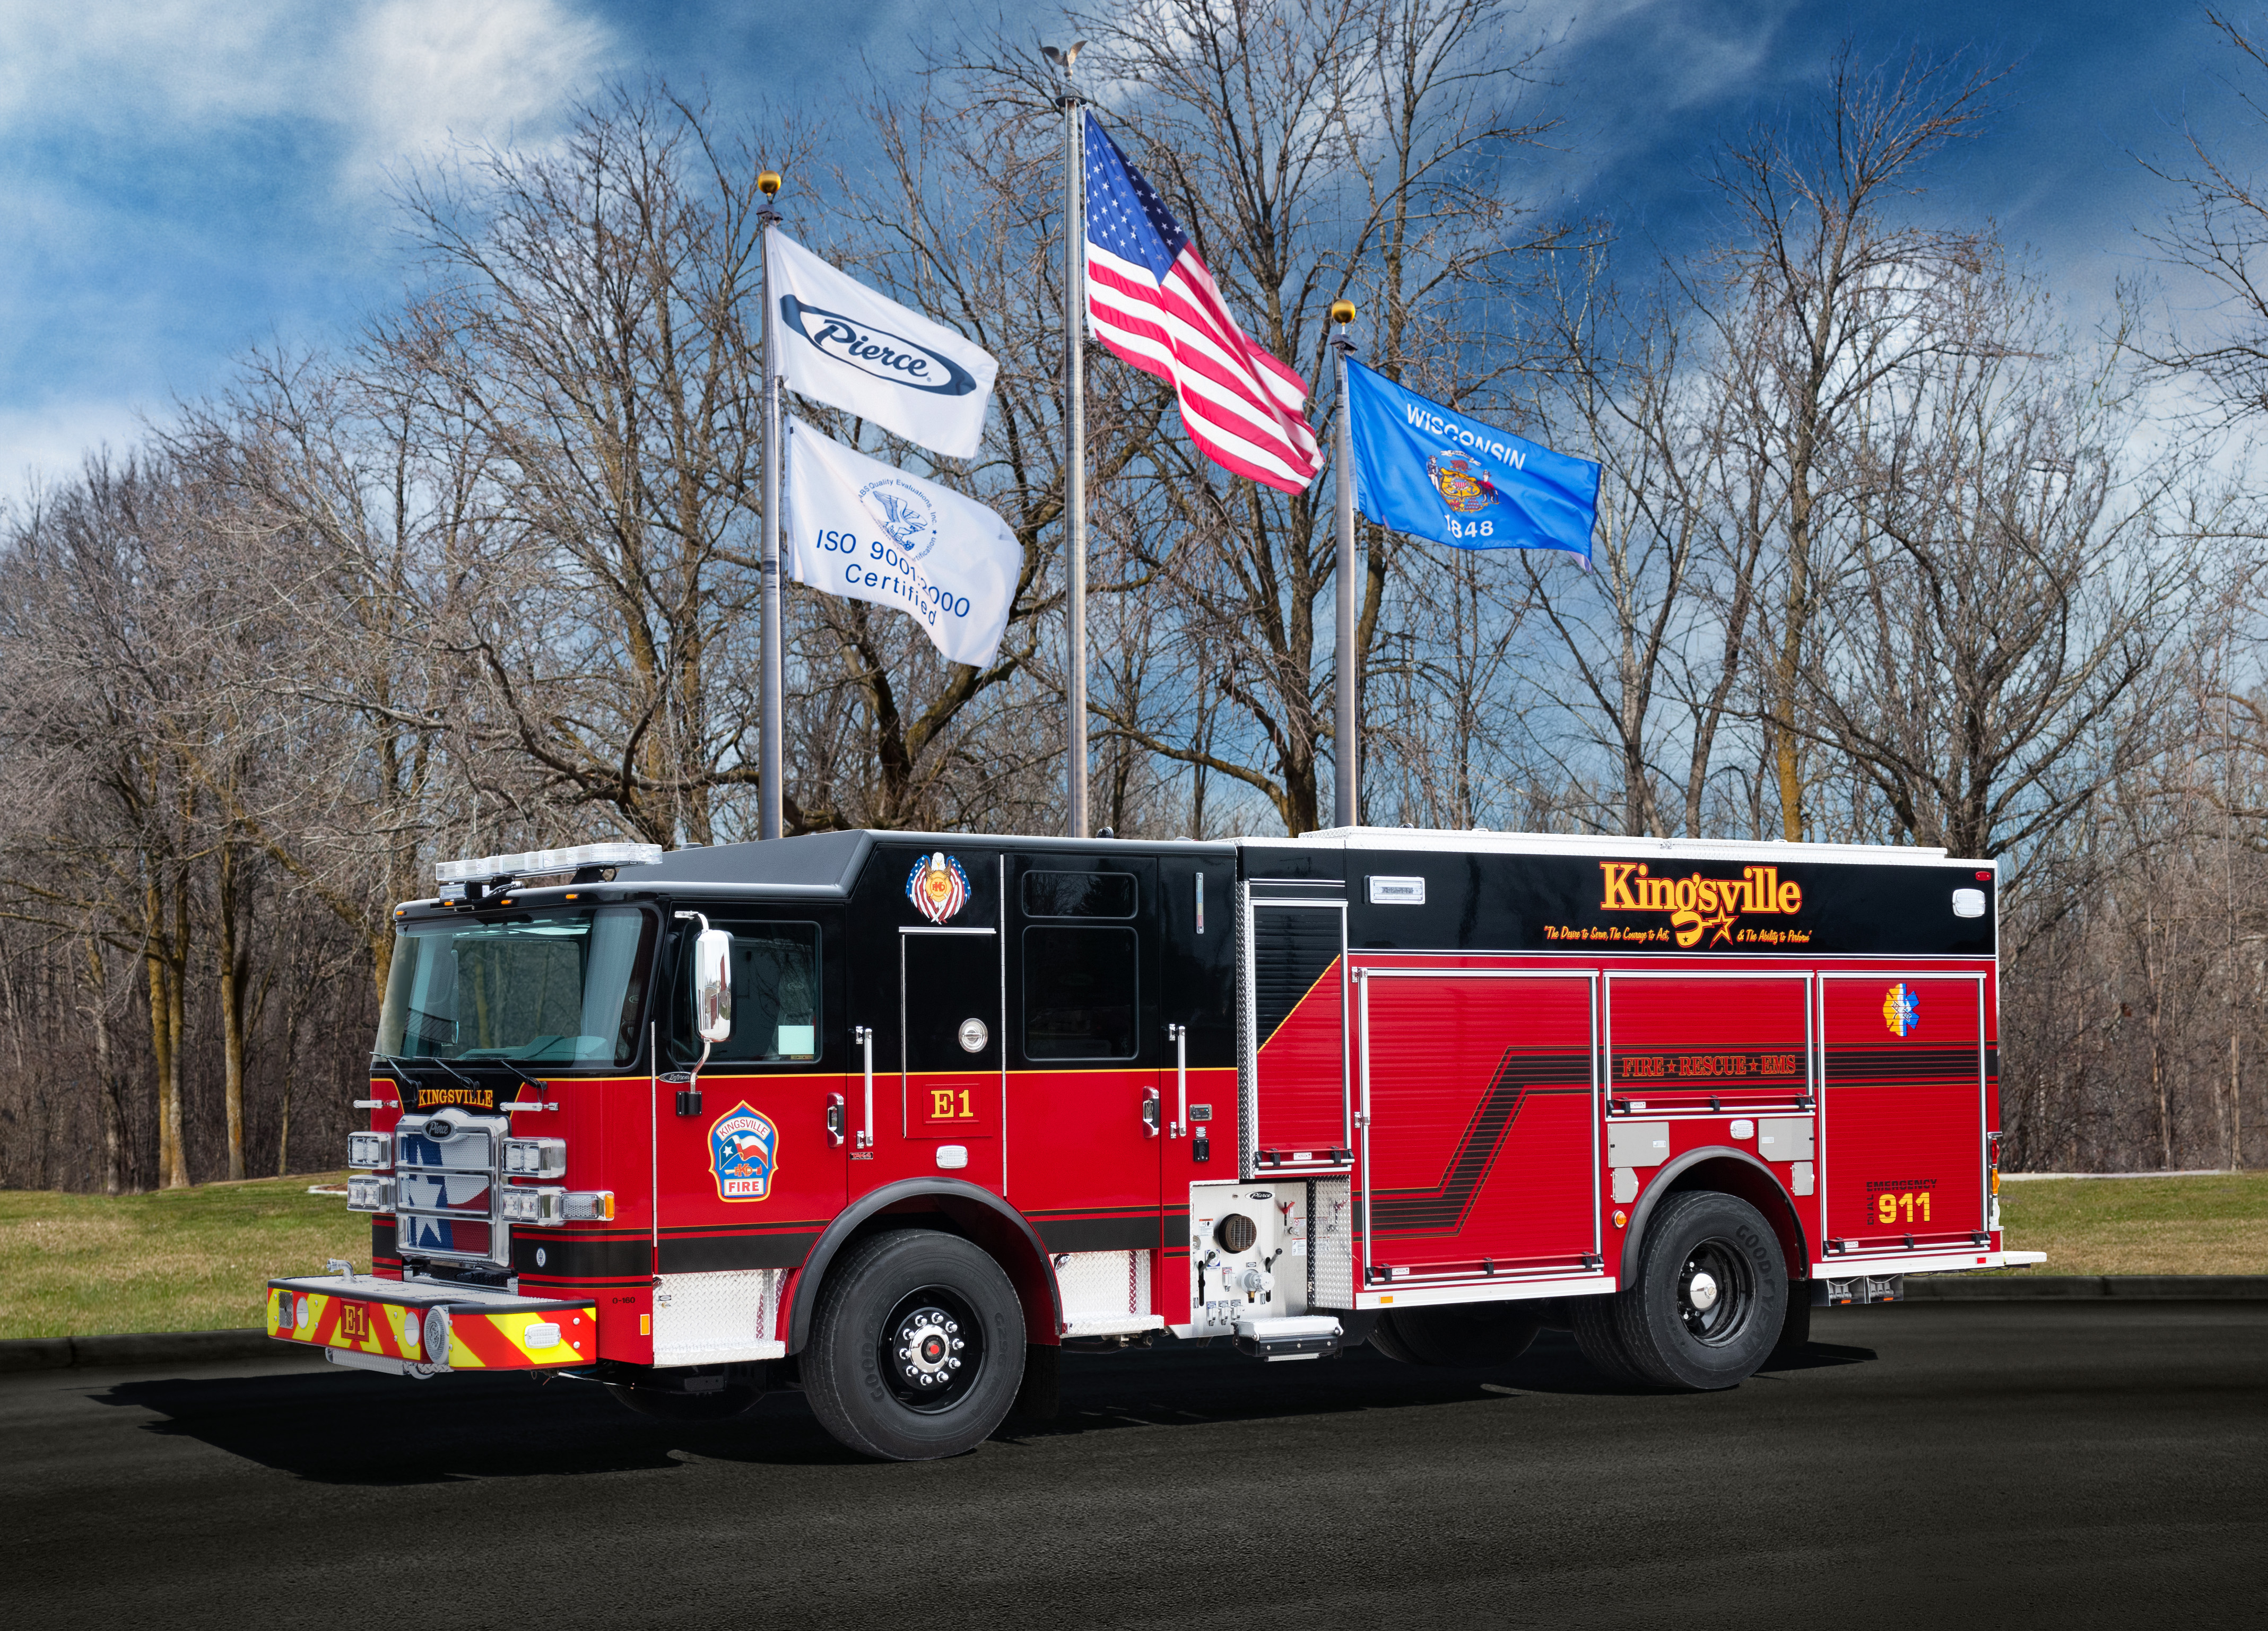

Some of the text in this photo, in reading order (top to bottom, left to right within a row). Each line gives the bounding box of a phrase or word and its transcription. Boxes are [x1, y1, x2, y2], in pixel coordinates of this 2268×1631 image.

[814, 319, 929, 377] Pierce
[1407, 404, 1526, 470] WISCONSIN
[858, 485, 870, 500] ABS
[868, 478, 893, 490] Quality
[1444, 514, 1493, 539] 1848
[816, 529, 856, 554] ISO
[845, 564, 937, 626] Certified
[1599, 862, 1803, 948] Kingsville
[1560, 926, 1580, 940] Desire
[1581, 928, 1589, 940] to
[1590, 927, 1609, 941] Serve,
[1610, 927, 1622, 940] The
[1623, 927, 1647, 944] Courage
[1648, 929, 1656, 940] to
[1656, 927, 1670, 941] Act,
[1736, 929, 1745, 942] &
[1746, 929, 1757, 942] The
[1758, 929, 1778, 945] Ability
[1779, 931, 1786, 943] to
[1622, 1054, 1796, 1077] FIRE RESCUE EMS
[418, 1089, 493, 1110] KINGSVILLE
[931, 1089, 974, 1118] E1
[429, 1121, 448, 1136] Pierce
[719, 1119, 768, 1137] KINGSVILLE
[729, 1181, 759, 1192] FIRE
[1866, 1179, 1937, 1192] EMERGENCY
[1879, 1191, 1931, 1224] 911
[344, 1305, 366, 1336] E1
